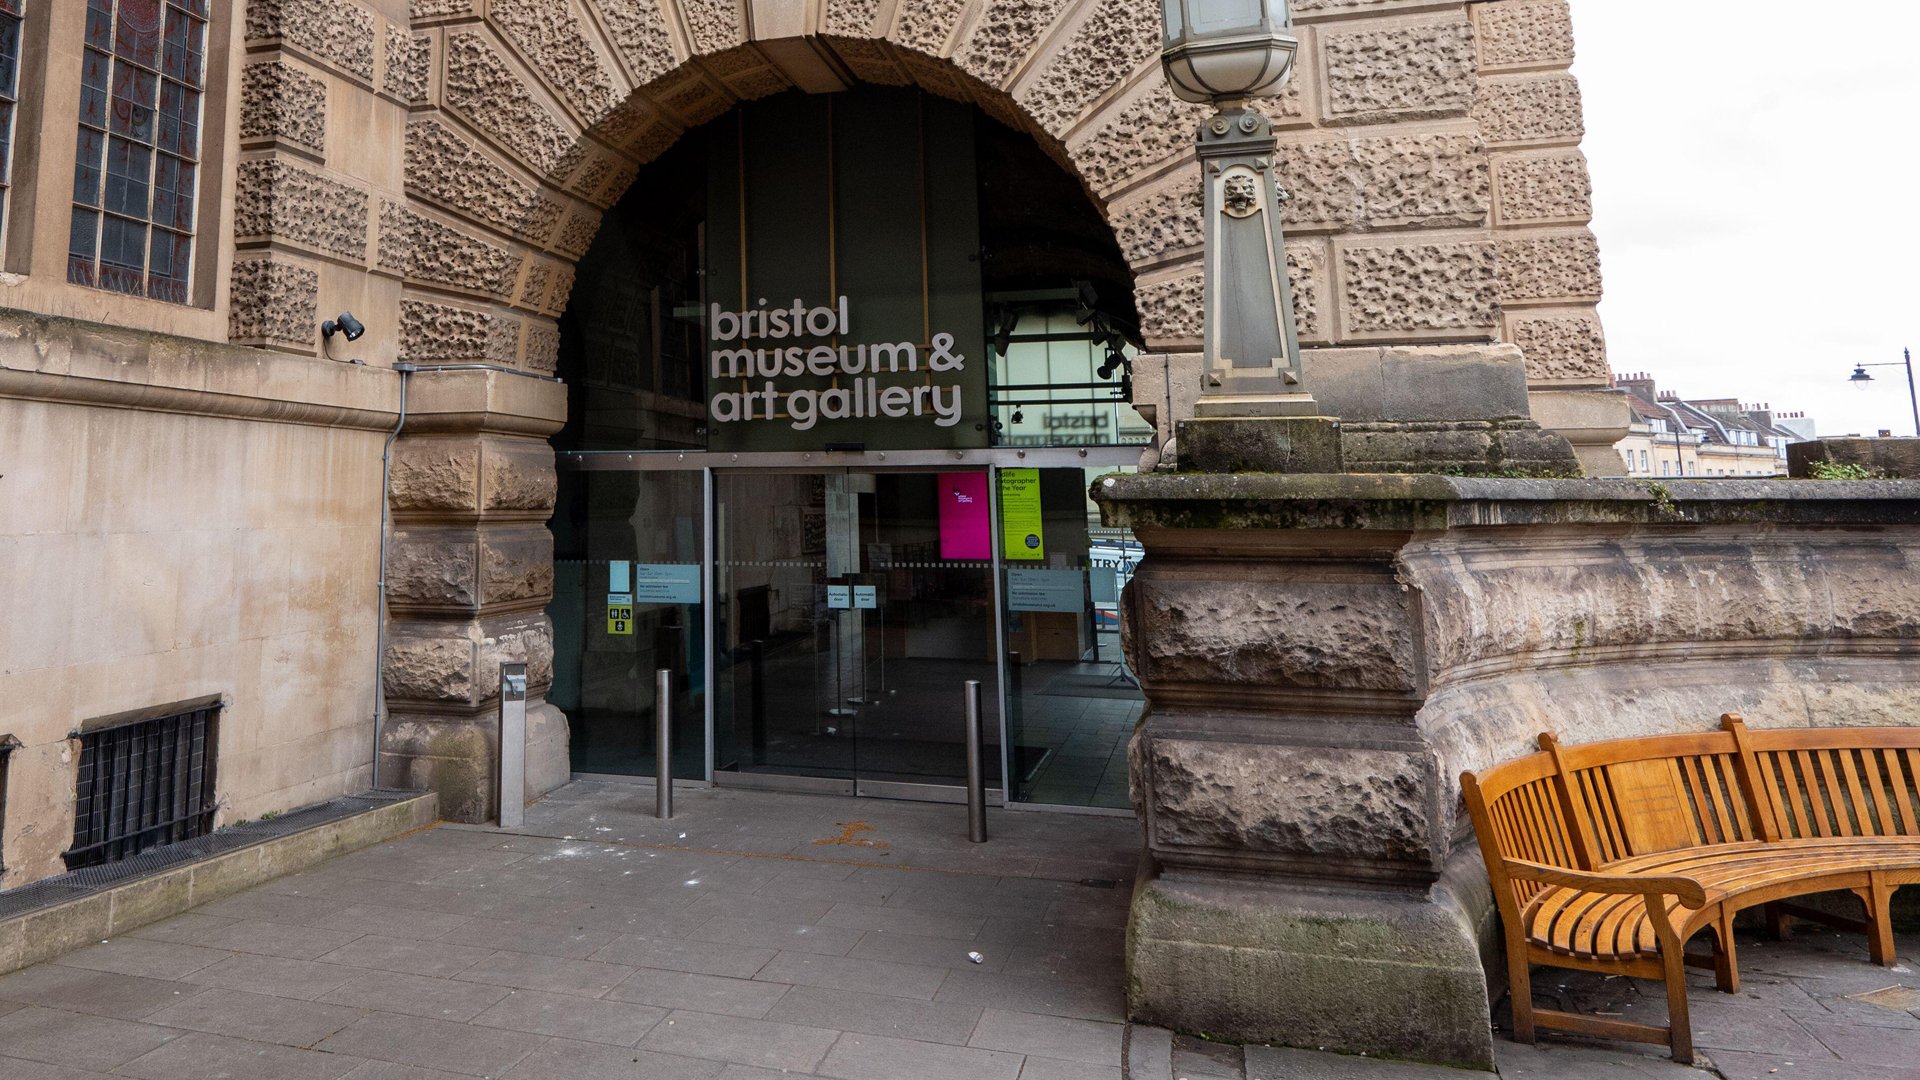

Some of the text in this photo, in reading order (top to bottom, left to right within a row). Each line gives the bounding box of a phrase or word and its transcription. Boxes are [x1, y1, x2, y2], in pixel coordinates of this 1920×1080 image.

[711, 295, 849, 341] bristol
[711, 332, 965, 378] museum &
[710, 377, 962, 430] art gallery
[1090, 558, 1120, 568] TRY
